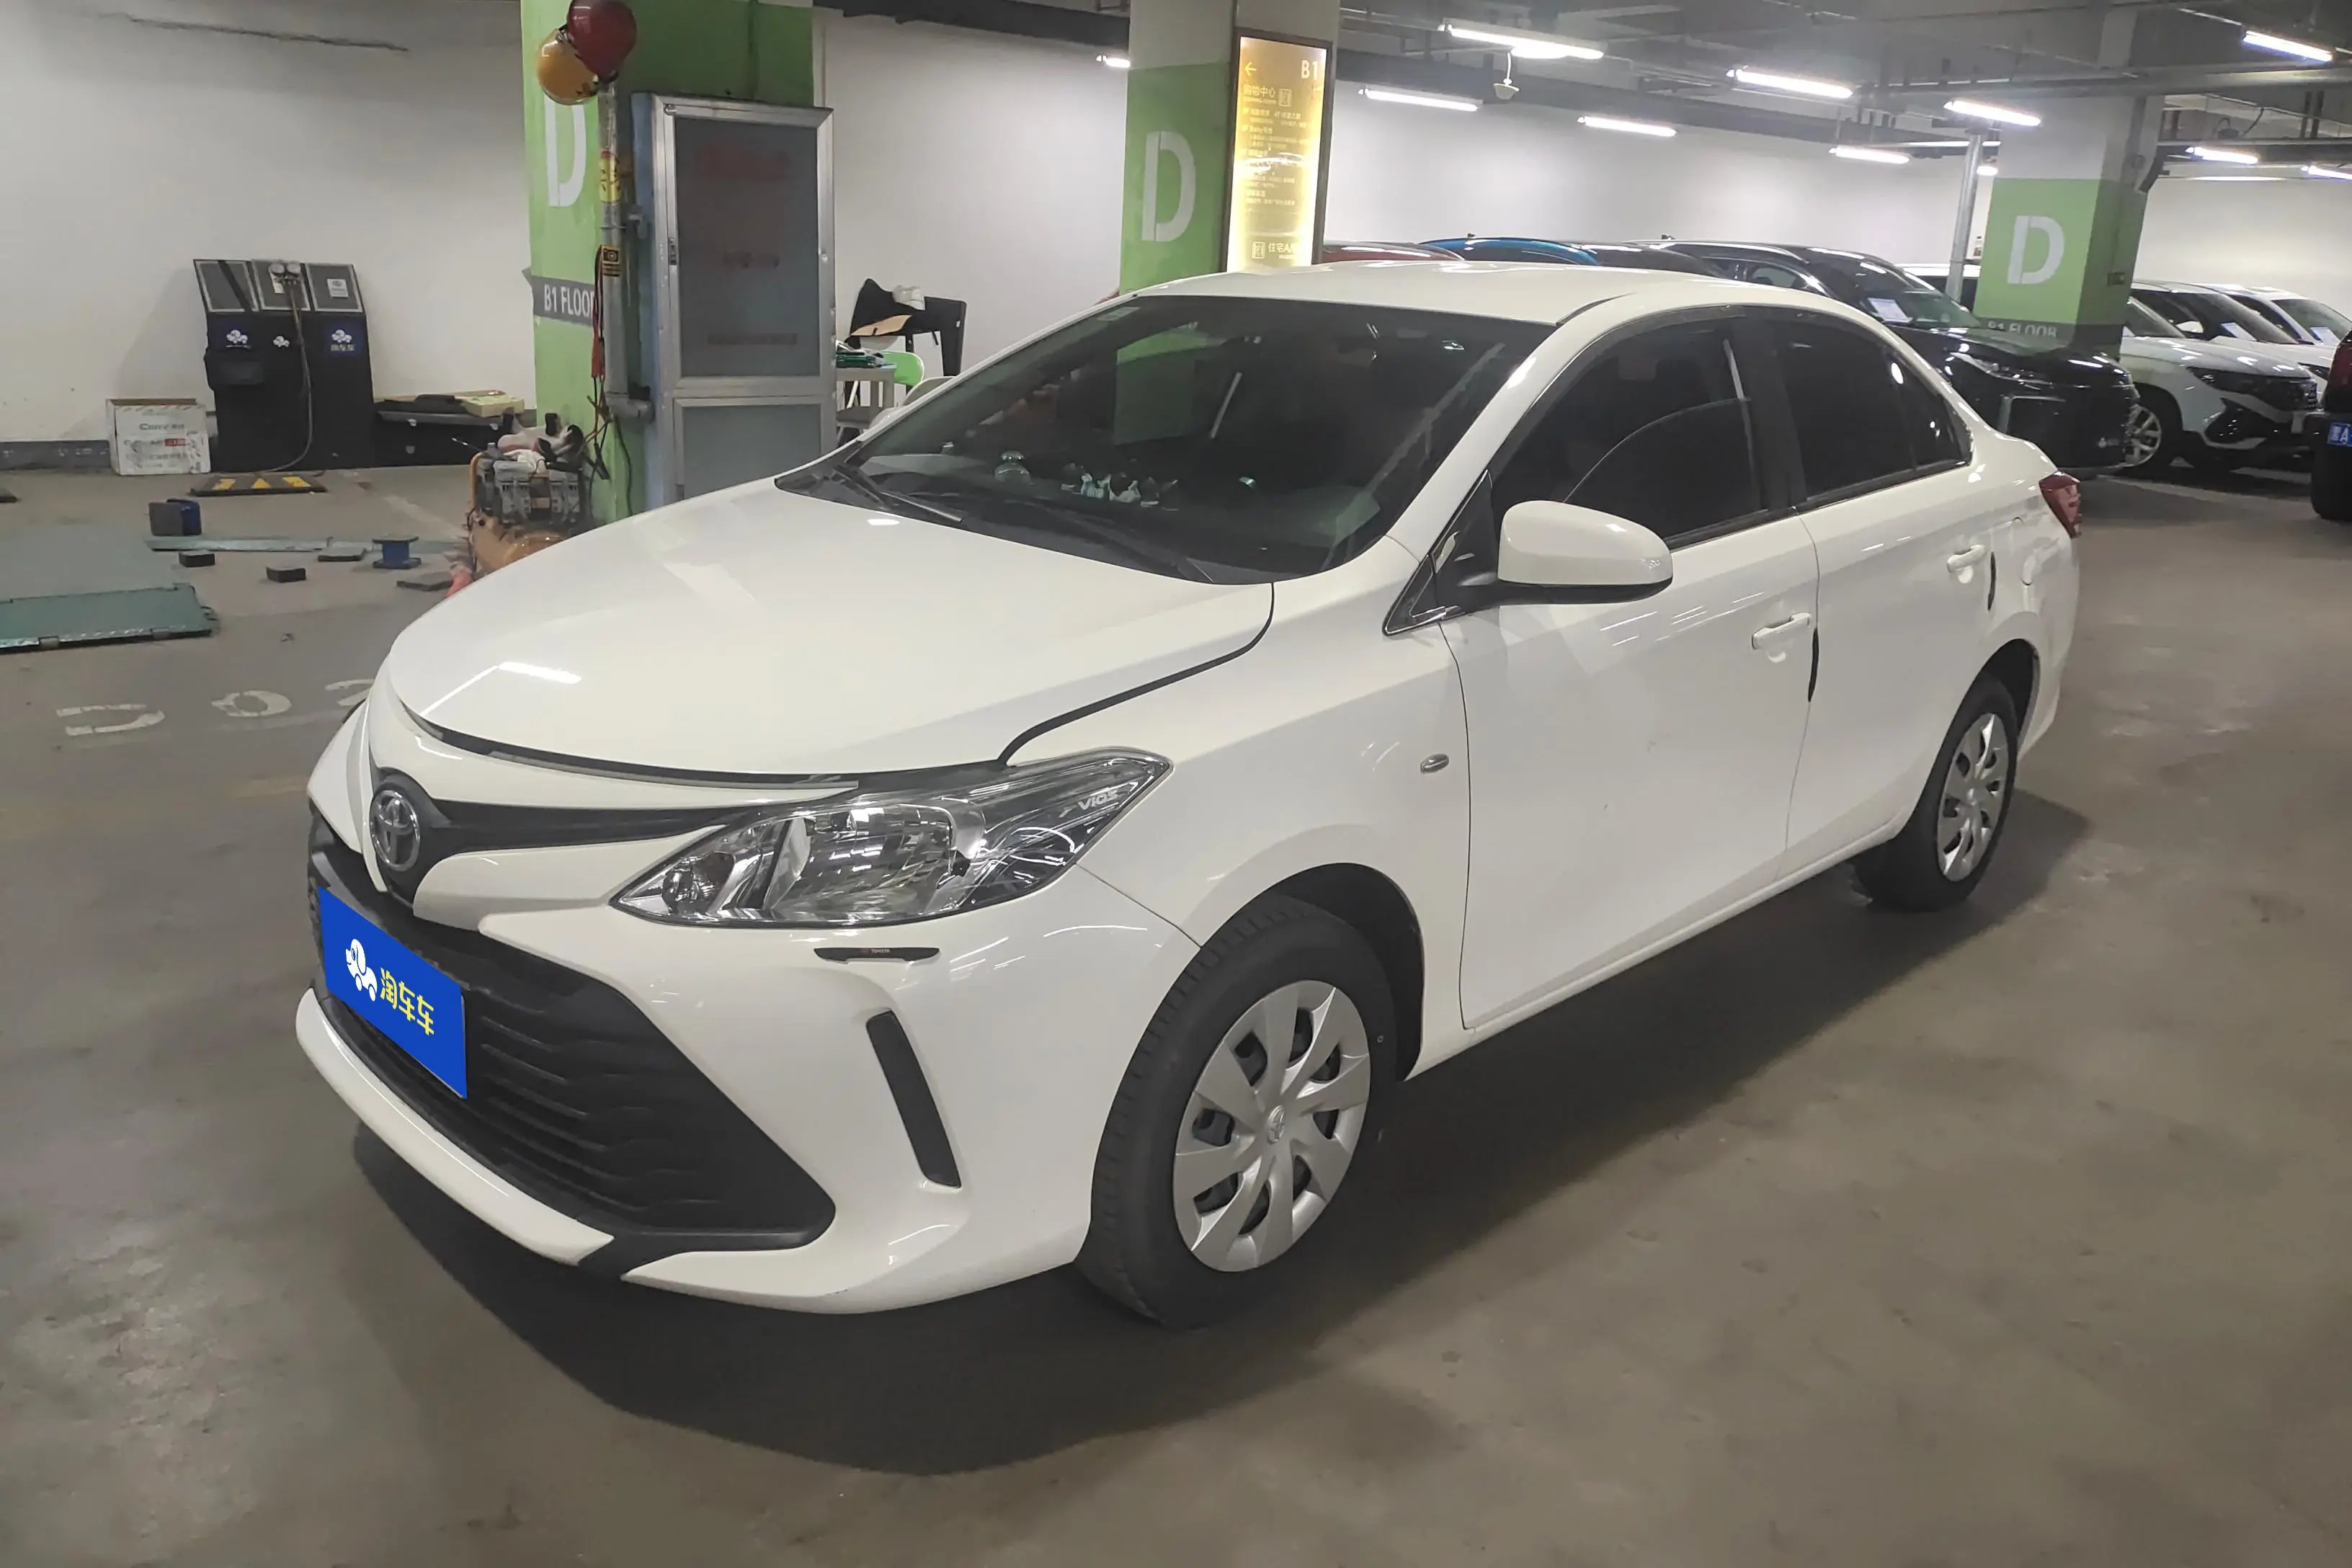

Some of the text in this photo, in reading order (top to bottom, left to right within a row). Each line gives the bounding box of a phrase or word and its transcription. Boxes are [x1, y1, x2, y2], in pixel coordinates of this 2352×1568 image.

[1301, 60, 1319, 81] B1
[545, 91, 587, 207] D
[1141, 130, 1196, 241] D
[2007, 215, 2065, 284] D
[545, 284, 557, 313] B1
[1077, 789, 1118, 811] VIOS
